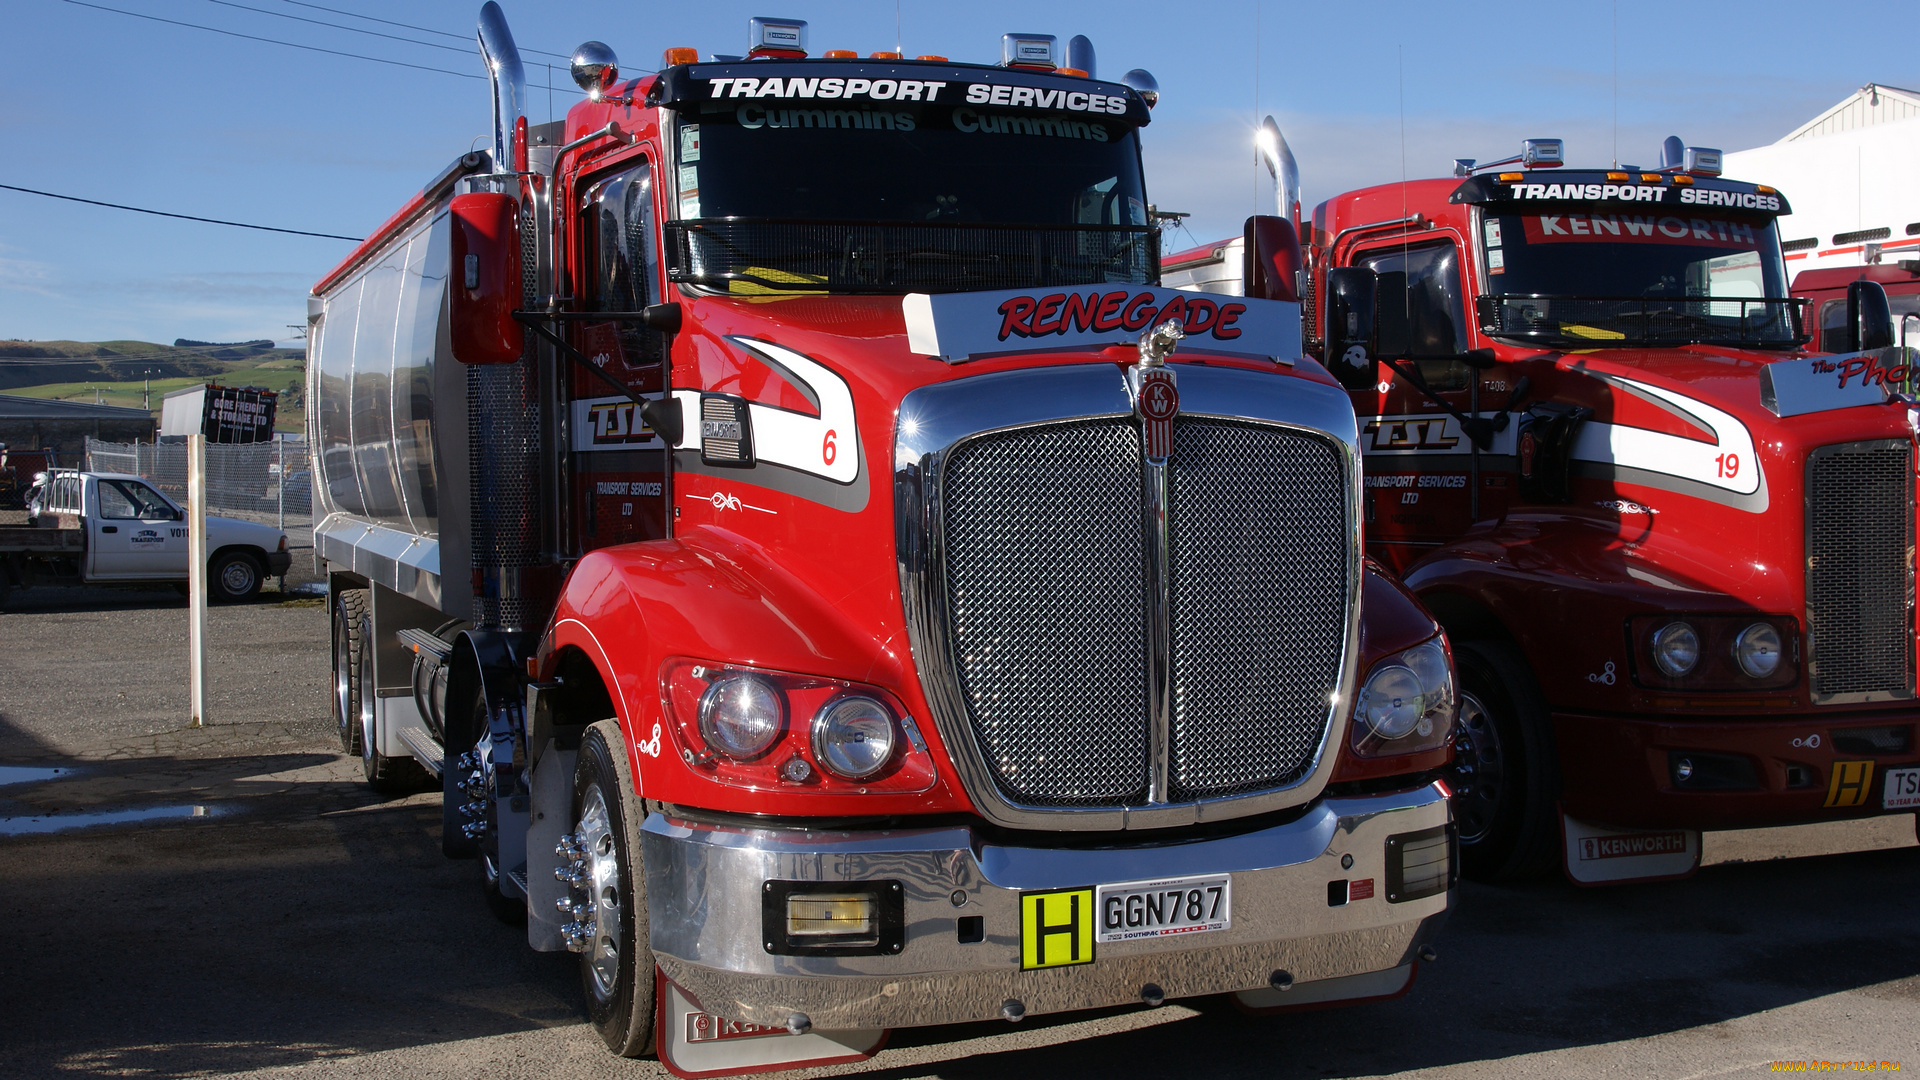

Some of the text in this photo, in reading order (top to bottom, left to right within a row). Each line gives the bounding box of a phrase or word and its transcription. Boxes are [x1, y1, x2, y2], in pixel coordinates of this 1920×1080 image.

[709, 78, 1127, 115] TRANSPORT SERVICES
[736, 103, 916, 132] Cummins
[952, 107, 1109, 142] Cummins
[1511, 184, 1780, 210] TRANSPORT SERVICES
[1540, 213, 1754, 244] KENWORTH
[998, 291, 1246, 341] RENEGADE
[1811, 360, 1836, 374] The
[1484, 381, 1506, 392] T408
[589, 402, 657, 444] TSL
[1364, 418, 1459, 450] TSL
[822, 429, 837, 466] 6
[1715, 453, 1739, 479] 19
[597, 482, 662, 497] TRANSPORT SERVICES
[1417, 476, 1466, 488] SERVICES
[622, 502, 633, 516] LTD
[1401, 492, 1419, 505] LTD
[1831, 763, 1867, 806] H
[1895, 772, 1920, 796] TS
[1601, 835, 1683, 855] KENWORTH
[1104, 886, 1223, 930] GGN787
[1035, 894, 1080, 966] H
[1124, 930, 1159, 939] SOUTHPAC
[1161, 925, 1207, 934] TRUCKS
